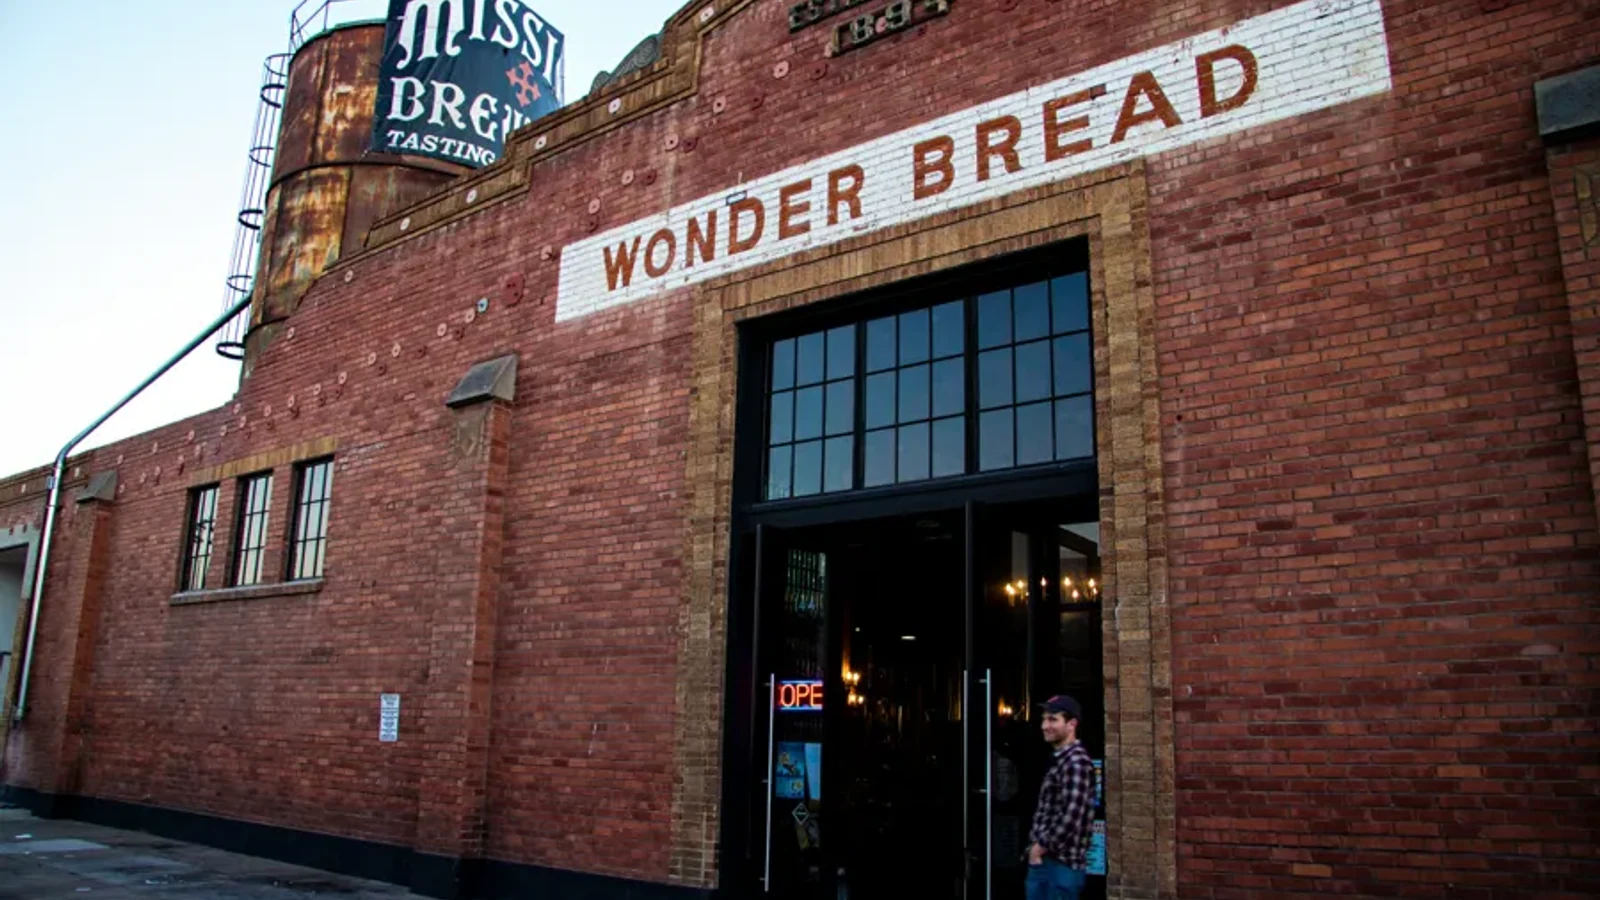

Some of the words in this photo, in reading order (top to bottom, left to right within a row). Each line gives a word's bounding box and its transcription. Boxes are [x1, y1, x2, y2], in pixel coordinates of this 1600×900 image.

[386, 129, 496, 166] TASTING
[602, 163, 865, 291] WONDER
[913, 44, 1259, 200] BREAD
